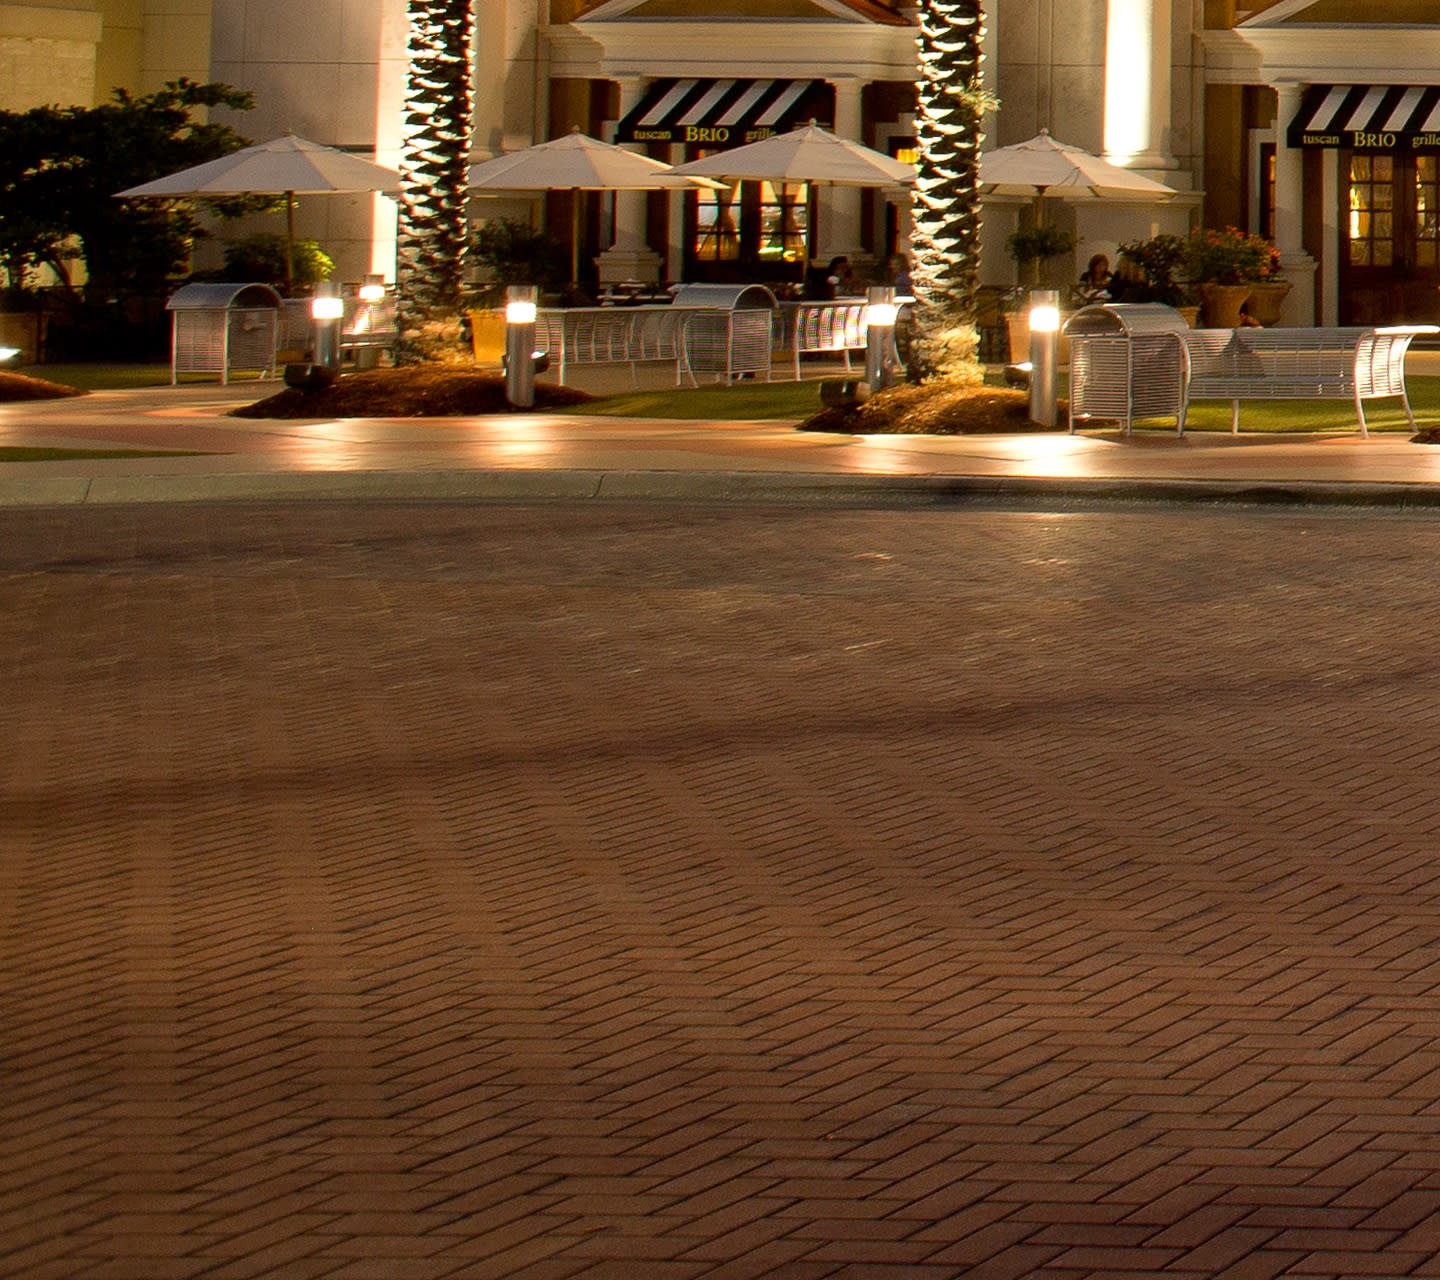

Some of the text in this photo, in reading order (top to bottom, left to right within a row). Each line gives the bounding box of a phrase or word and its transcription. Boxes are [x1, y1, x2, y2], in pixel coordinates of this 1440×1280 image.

[633, 129, 672, 140] tuscan
[685, 126, 730, 142] BRIO
[1302, 134, 1341, 145] tuscan
[1353, 131, 1397, 148] BRIO
